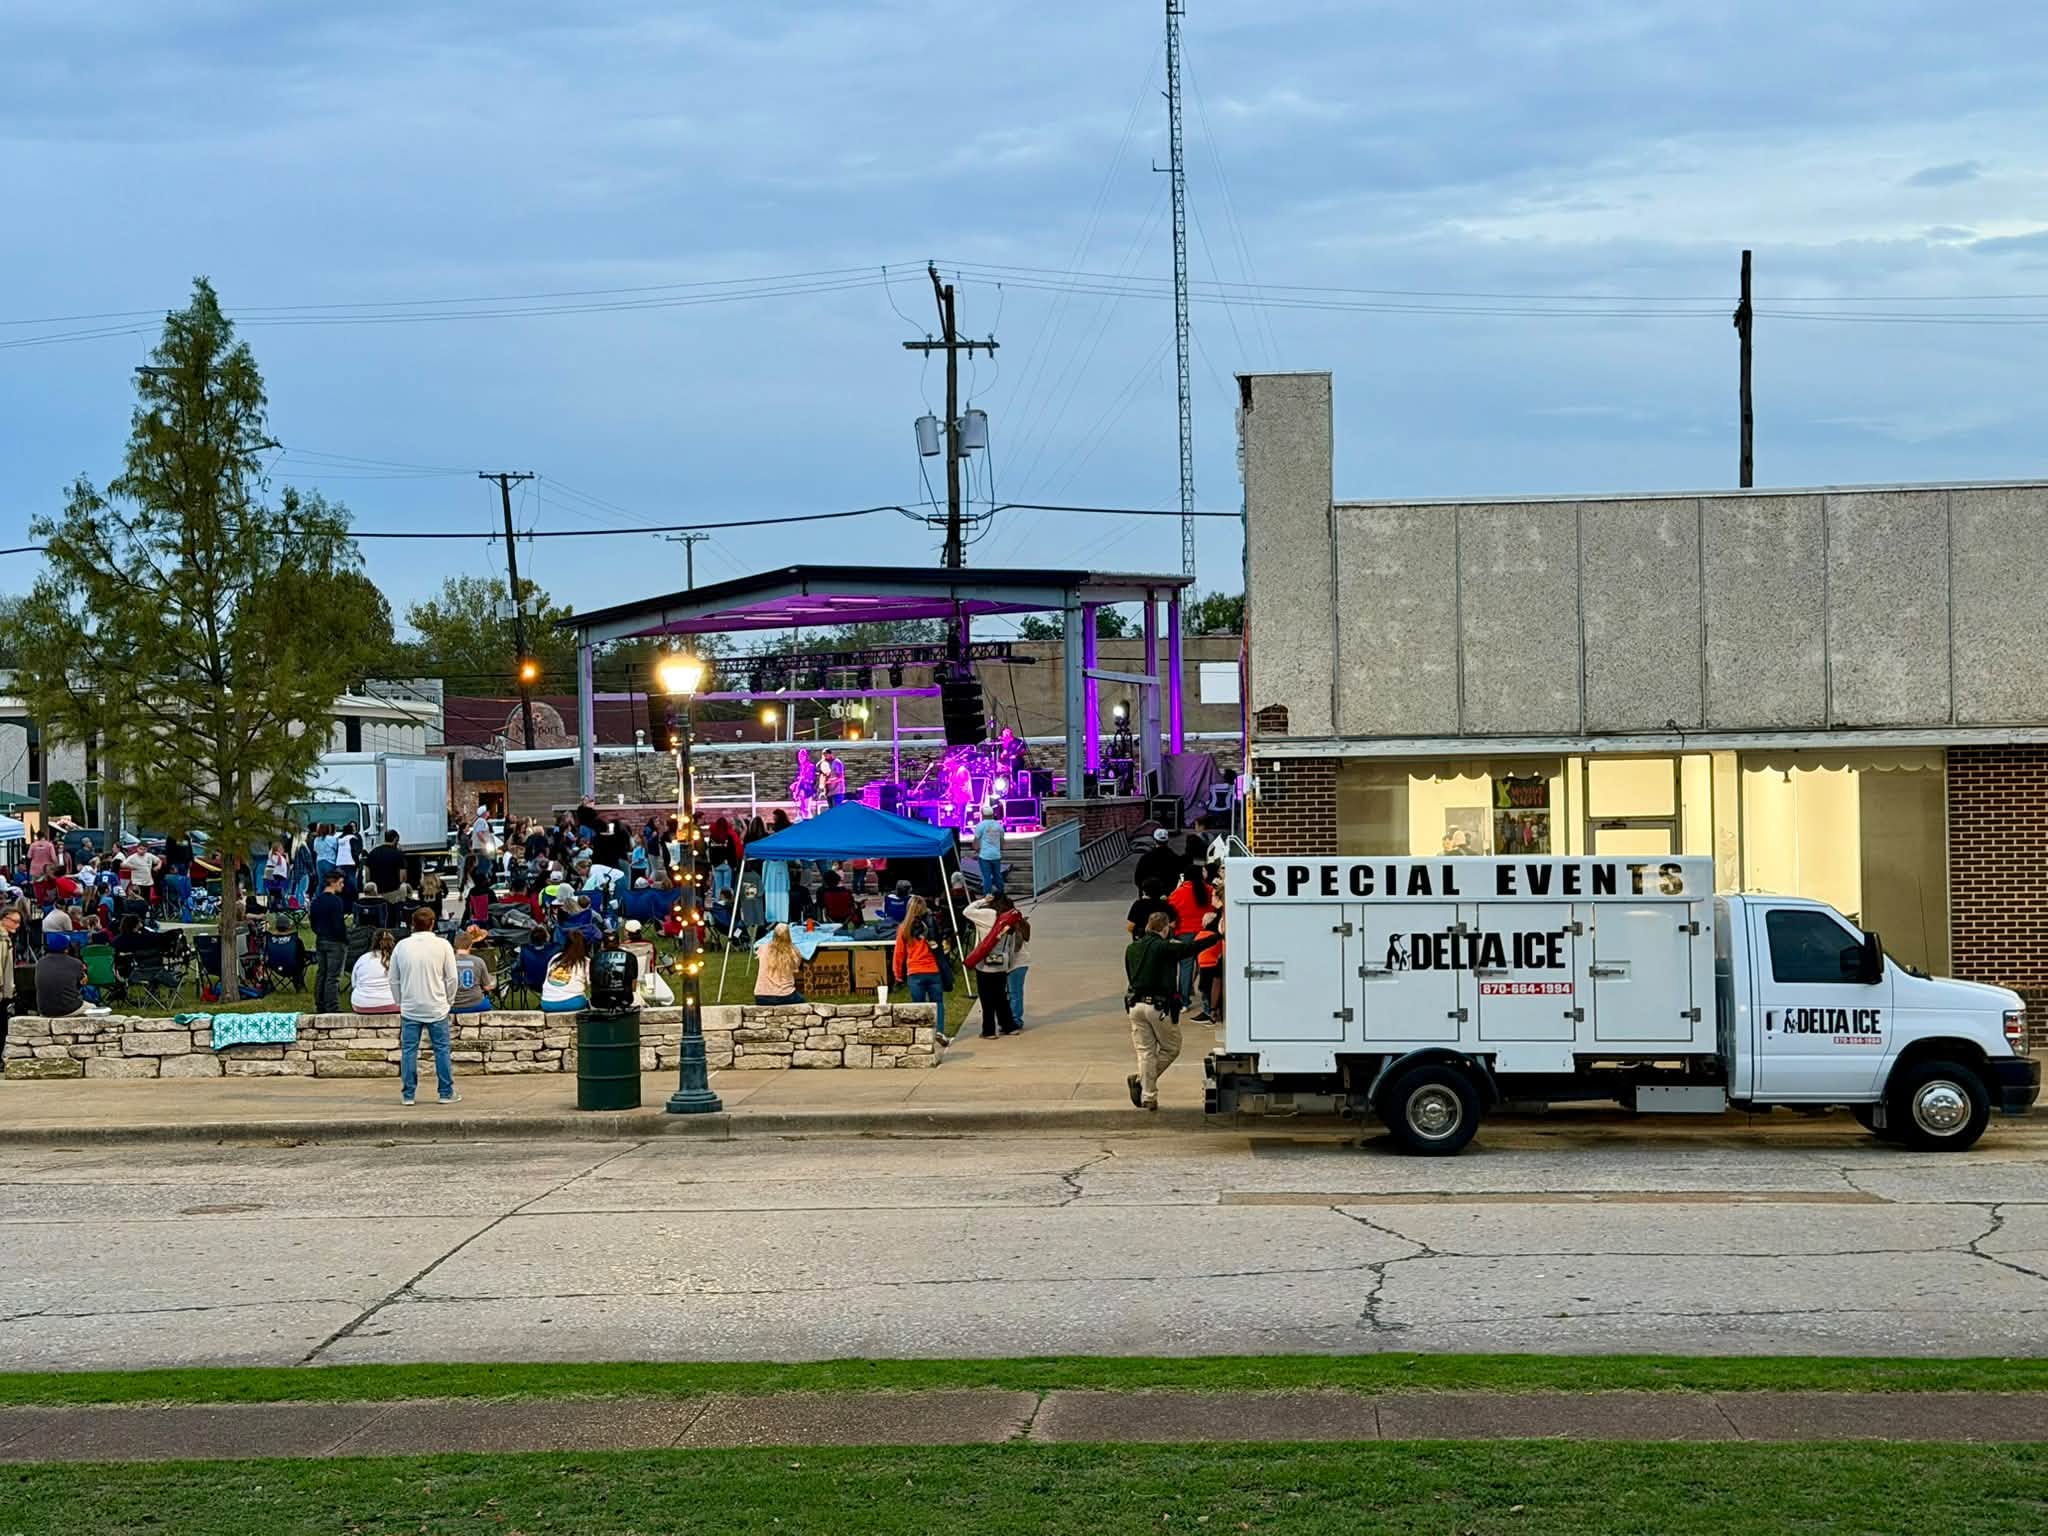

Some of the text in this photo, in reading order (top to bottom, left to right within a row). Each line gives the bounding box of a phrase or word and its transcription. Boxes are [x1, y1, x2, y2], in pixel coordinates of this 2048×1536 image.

[1252, 862, 1684, 897] SPECIAL EVENTS
[1411, 931, 1566, 971] DELTA ICE
[1797, 1008, 1882, 1034] DELTA ICE
